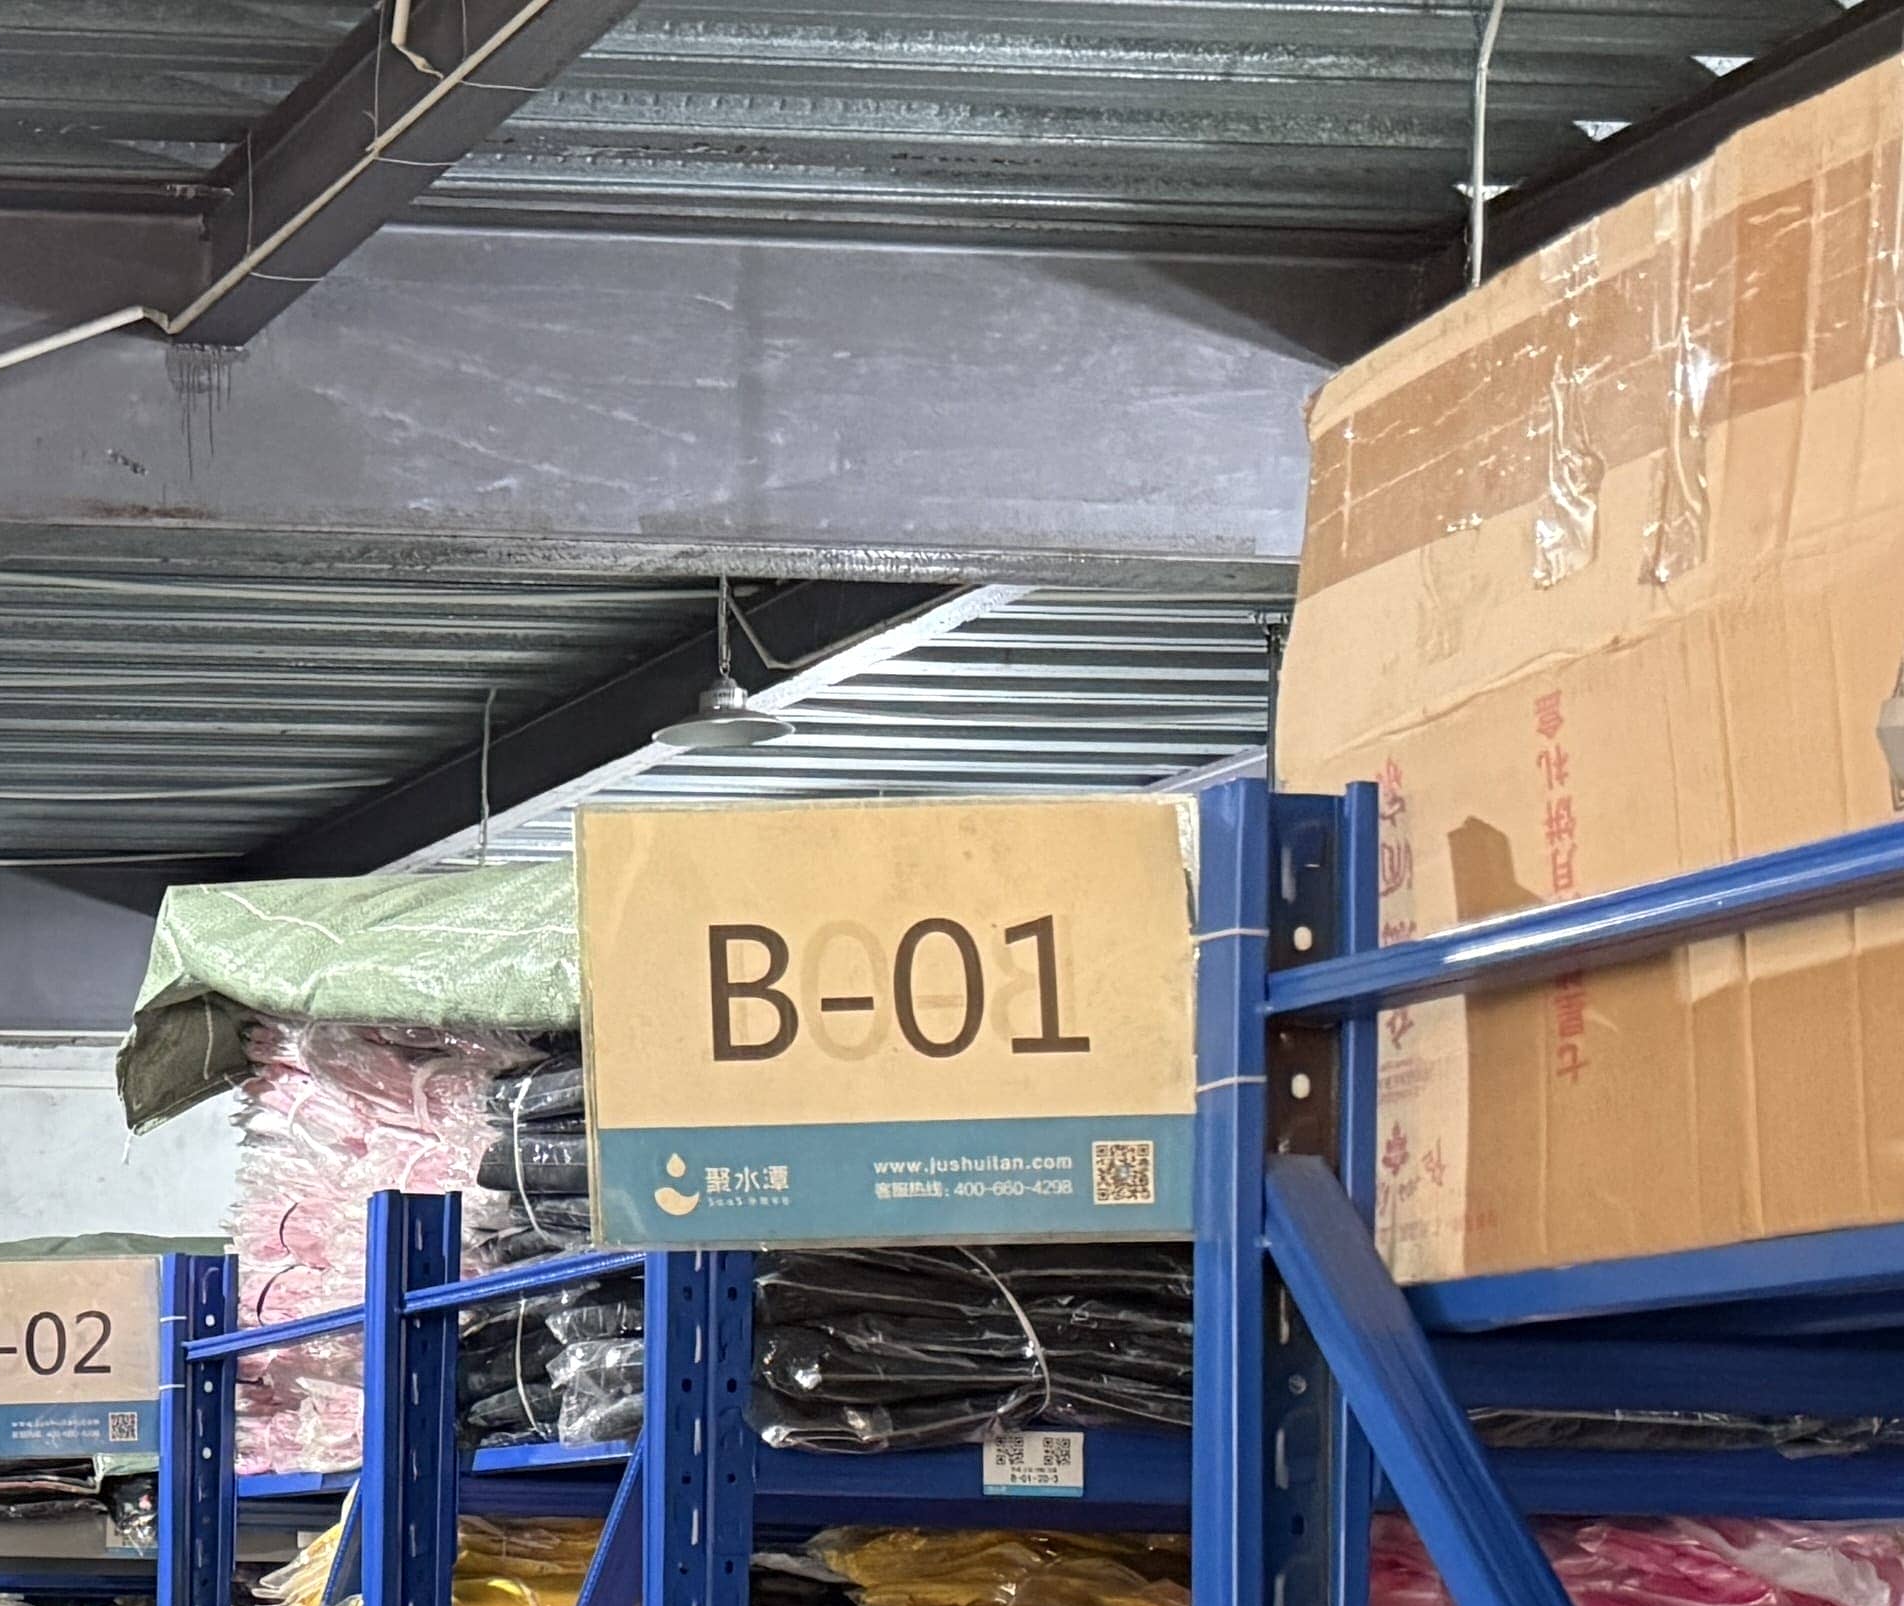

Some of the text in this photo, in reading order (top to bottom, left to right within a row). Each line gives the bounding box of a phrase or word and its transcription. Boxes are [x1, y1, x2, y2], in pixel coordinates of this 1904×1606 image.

[707, 914, 1091, 1063] B-01
[704, 1164, 790, 1193] 聚水潭
[873, 1155, 1073, 1175] www.jushuitan.com
